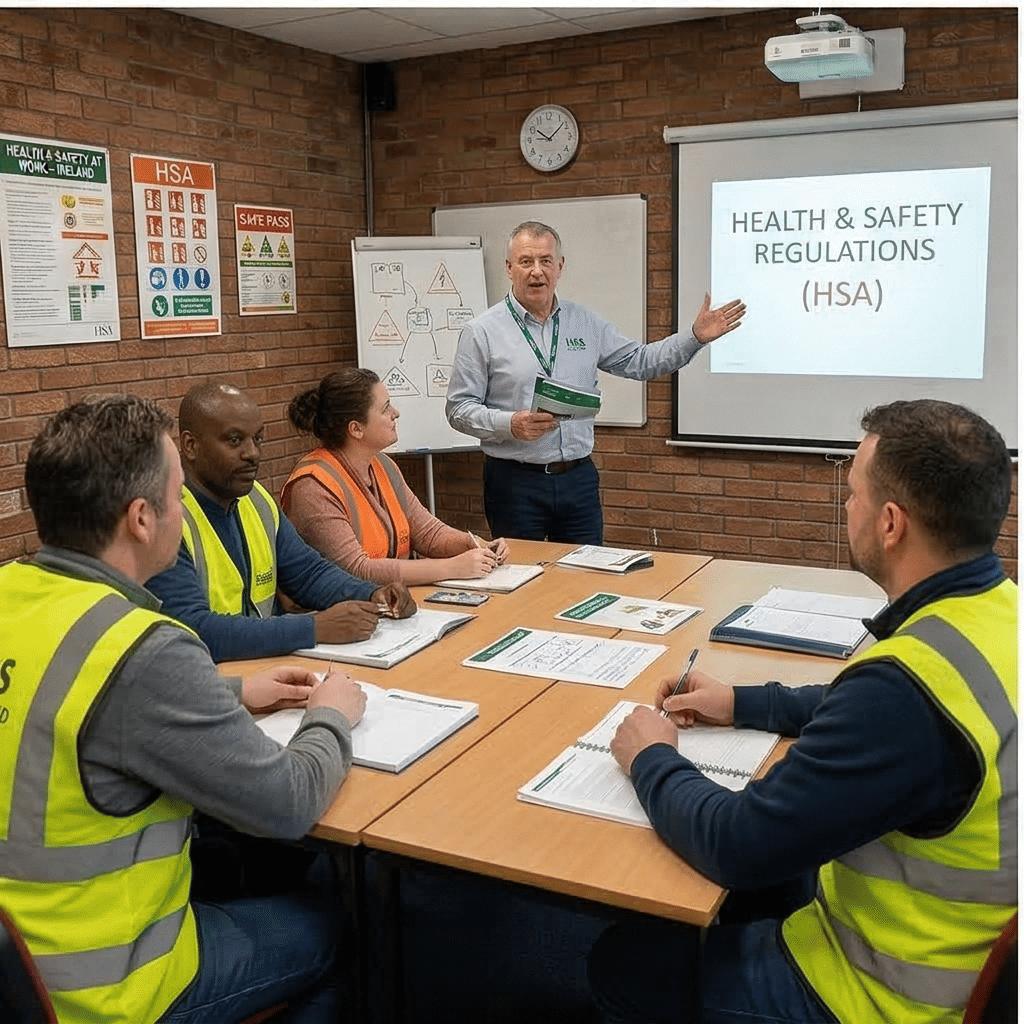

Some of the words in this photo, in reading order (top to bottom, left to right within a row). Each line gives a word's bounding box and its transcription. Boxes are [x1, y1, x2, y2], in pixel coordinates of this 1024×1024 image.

[91, 155, 103, 167] AT
[155, 161, 195, 186] HSA
[266, 215, 290, 228] PASS
[732, 207, 826, 233] HEALTH
[835, 207, 856, 230] &
[863, 202, 963, 229] SAFETY
[755, 237, 936, 264] REGULATIONS
[802, 279, 883, 313] (HSA)
